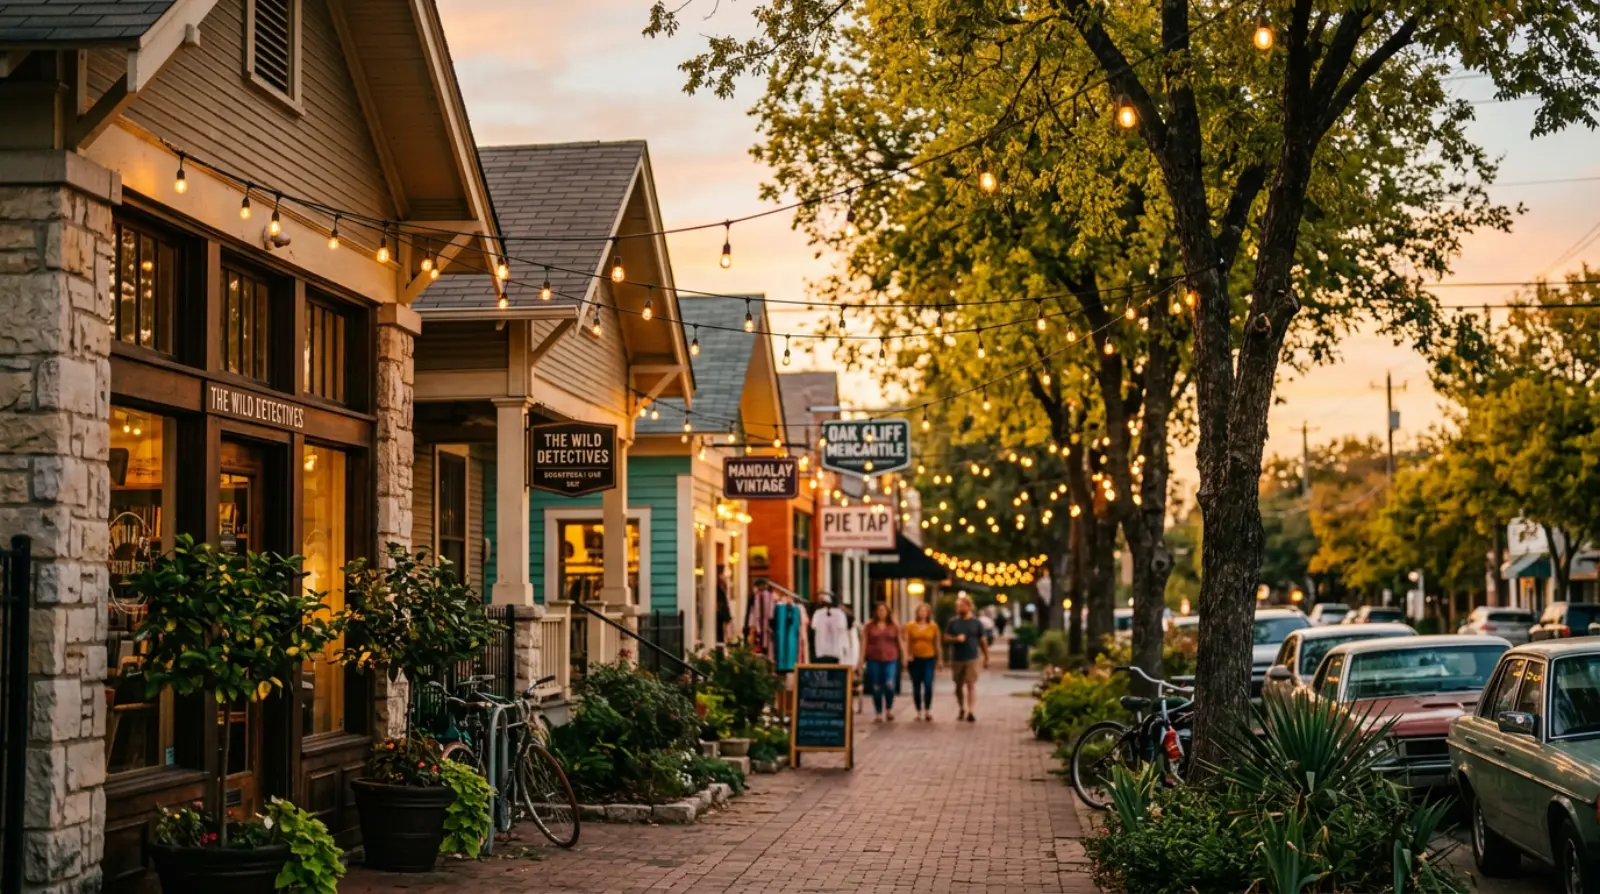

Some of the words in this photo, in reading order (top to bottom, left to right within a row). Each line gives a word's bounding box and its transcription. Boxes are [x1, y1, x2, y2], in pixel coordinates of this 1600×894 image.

[211, 386, 229, 412] THE
[231, 391, 254, 417] WILD
[256, 397, 304, 428] DETECTIVES
[544, 433, 568, 447] THE
[571, 433, 602, 447] WILD
[828, 425, 858, 442] OAK
[537, 450, 609, 463] DETECTIVES
[728, 463, 793, 478] MANDALAY
[736, 478, 786, 493] VINTAGE
[824, 513, 851, 532] PIE
[857, 513, 889, 532] TAP
